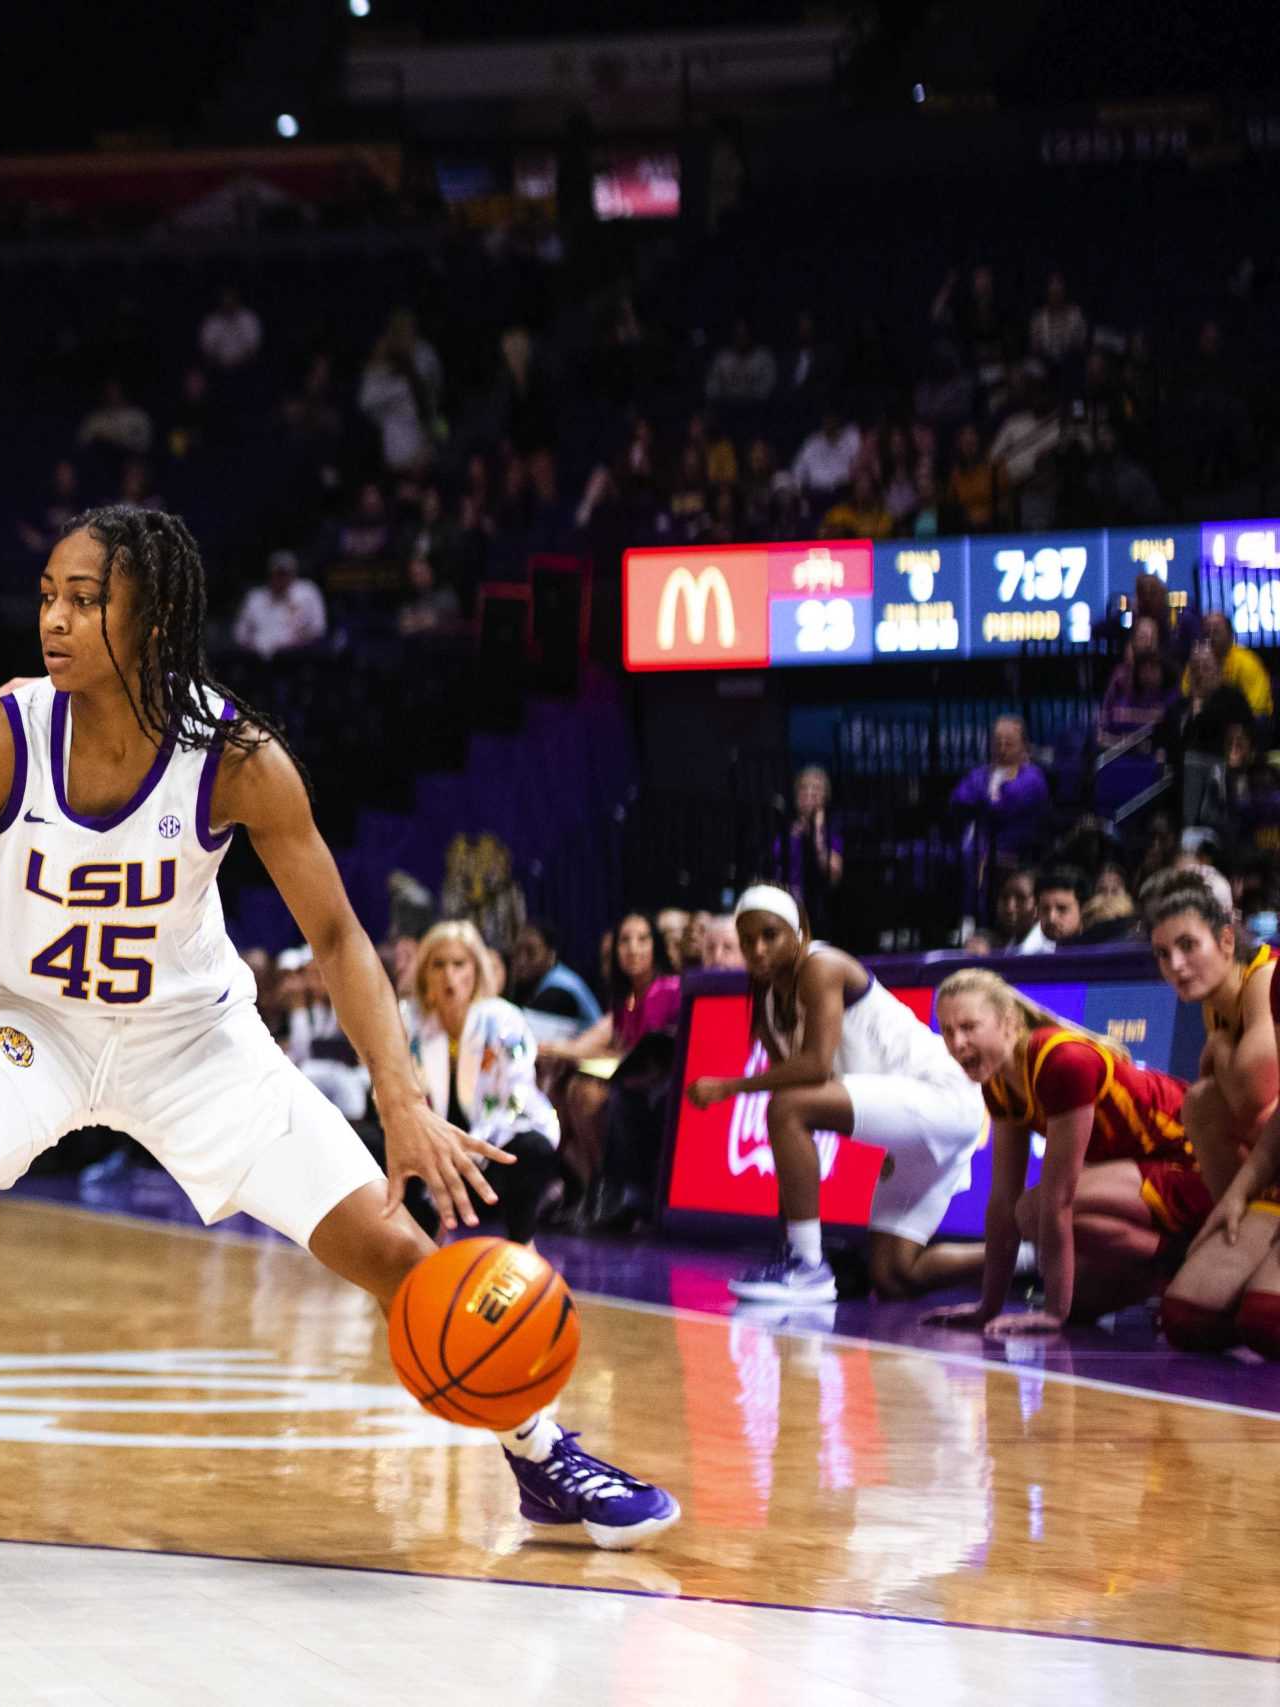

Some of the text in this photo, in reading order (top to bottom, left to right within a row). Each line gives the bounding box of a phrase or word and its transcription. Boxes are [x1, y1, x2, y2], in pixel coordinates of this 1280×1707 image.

[993, 546, 1088, 602] 7:37
[983, 610, 1060, 642] PERIOD
[159, 816, 180, 838] SEC
[24, 847, 177, 909] LSU
[29, 921, 158, 1005] 45
